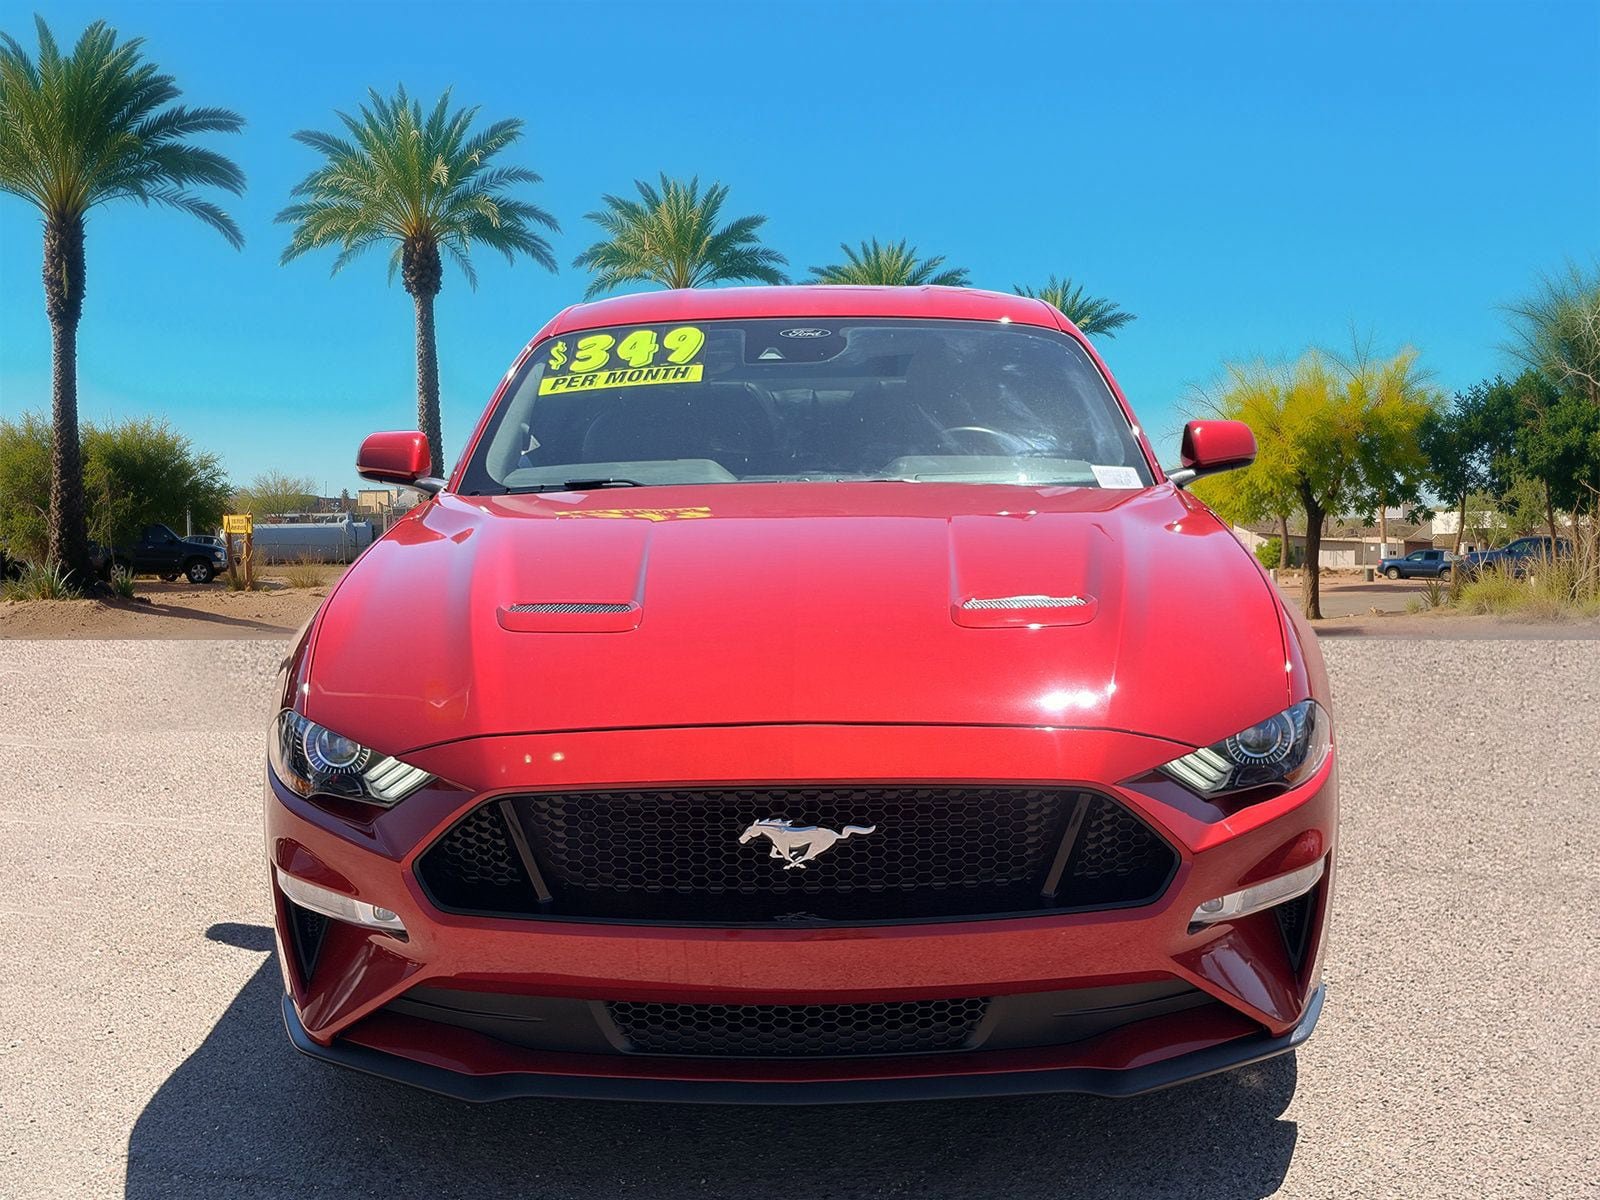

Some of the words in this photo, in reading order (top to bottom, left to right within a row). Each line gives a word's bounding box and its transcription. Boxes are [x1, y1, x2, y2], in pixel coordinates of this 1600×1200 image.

[788, 327, 822, 338] Ford
[549, 327, 705, 372] $349
[550, 374, 595, 391] PER
[604, 366, 691, 385] MONTH
